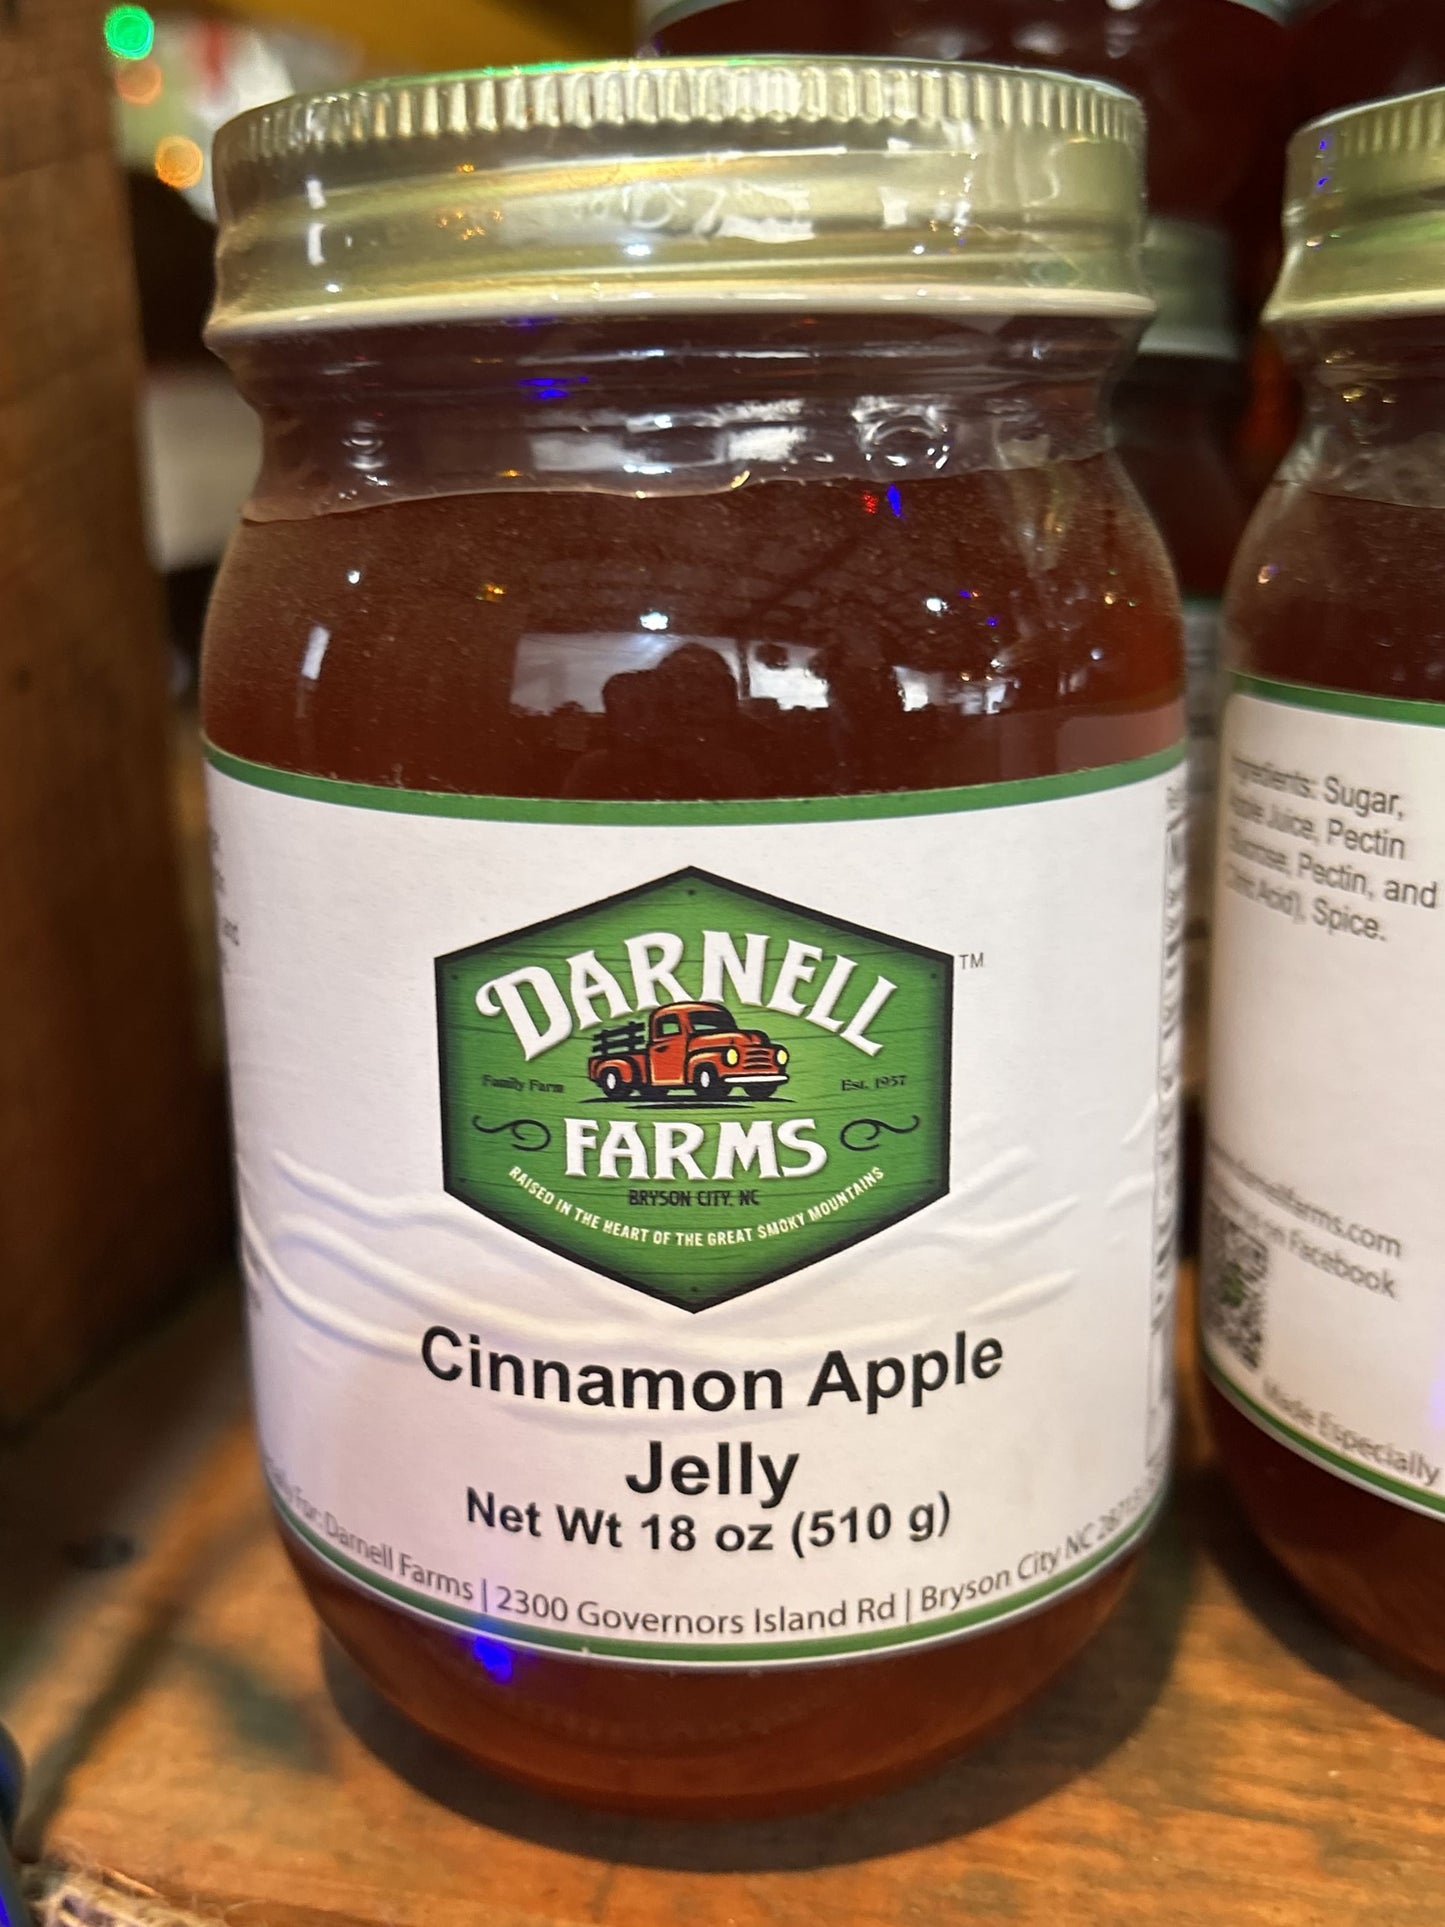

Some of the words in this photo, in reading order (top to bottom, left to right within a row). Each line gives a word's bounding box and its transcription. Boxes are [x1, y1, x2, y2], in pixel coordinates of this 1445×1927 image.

[1324, 775, 1405, 821] Sugar,
[1327, 817, 1406, 860] Pectin
[1297, 851, 1374, 900] Pectin,
[1383, 879, 1438, 909] and
[1311, 896, 1388, 942] Spice.
[475, 929, 898, 1062] DARNELL
[529, 1079, 565, 1094] Farm
[841, 1078, 869, 1092] Est.
[875, 1074, 907, 1089] 1957
[563, 1116, 829, 1181] FARMS
[507, 1165, 556, 1206] RAISED
[555, 1198, 574, 1217] IN
[573, 1206, 602, 1230] THE
[602, 1219, 650, 1243] HEART
[652, 1230, 671, 1246] OF
[676, 1232, 704, 1247] THE
[707, 1227, 753, 1247] GREAT
[757, 1211, 806, 1240] SMOKY
[807, 1165, 885, 1222] MOUNTAINS
[628, 1188, 692, 1207] BRYSON
[738, 1188, 760, 1206] NC
[1288, 1228, 1398, 1300] Facebook
[420, 1325, 785, 1412] Cinnamon
[806, 1330, 1005, 1415] Apple
[625, 1440, 800, 1510] Jelly
[1318, 1410, 1440, 1487] Especially
[466, 1486, 542, 1538] Net
[556, 1503, 623, 1549] Wt
[641, 1514, 697, 1552] 18
[716, 1522, 775, 1553] oz
[791, 1502, 892, 1559] (510
[908, 1490, 952, 1543] g)
[324, 1509, 394, 1572] Darnell
[400, 1555, 475, 1601] Farms
[496, 1585, 569, 1622] 2300
[577, 1600, 745, 1636] Governors
[755, 1600, 848, 1633] Island
[857, 1593, 896, 1624] Rd
[920, 1568, 1011, 1612] Bryson
[1017, 1546, 1062, 1582] City
[1063, 1520, 1097, 1560] NC
